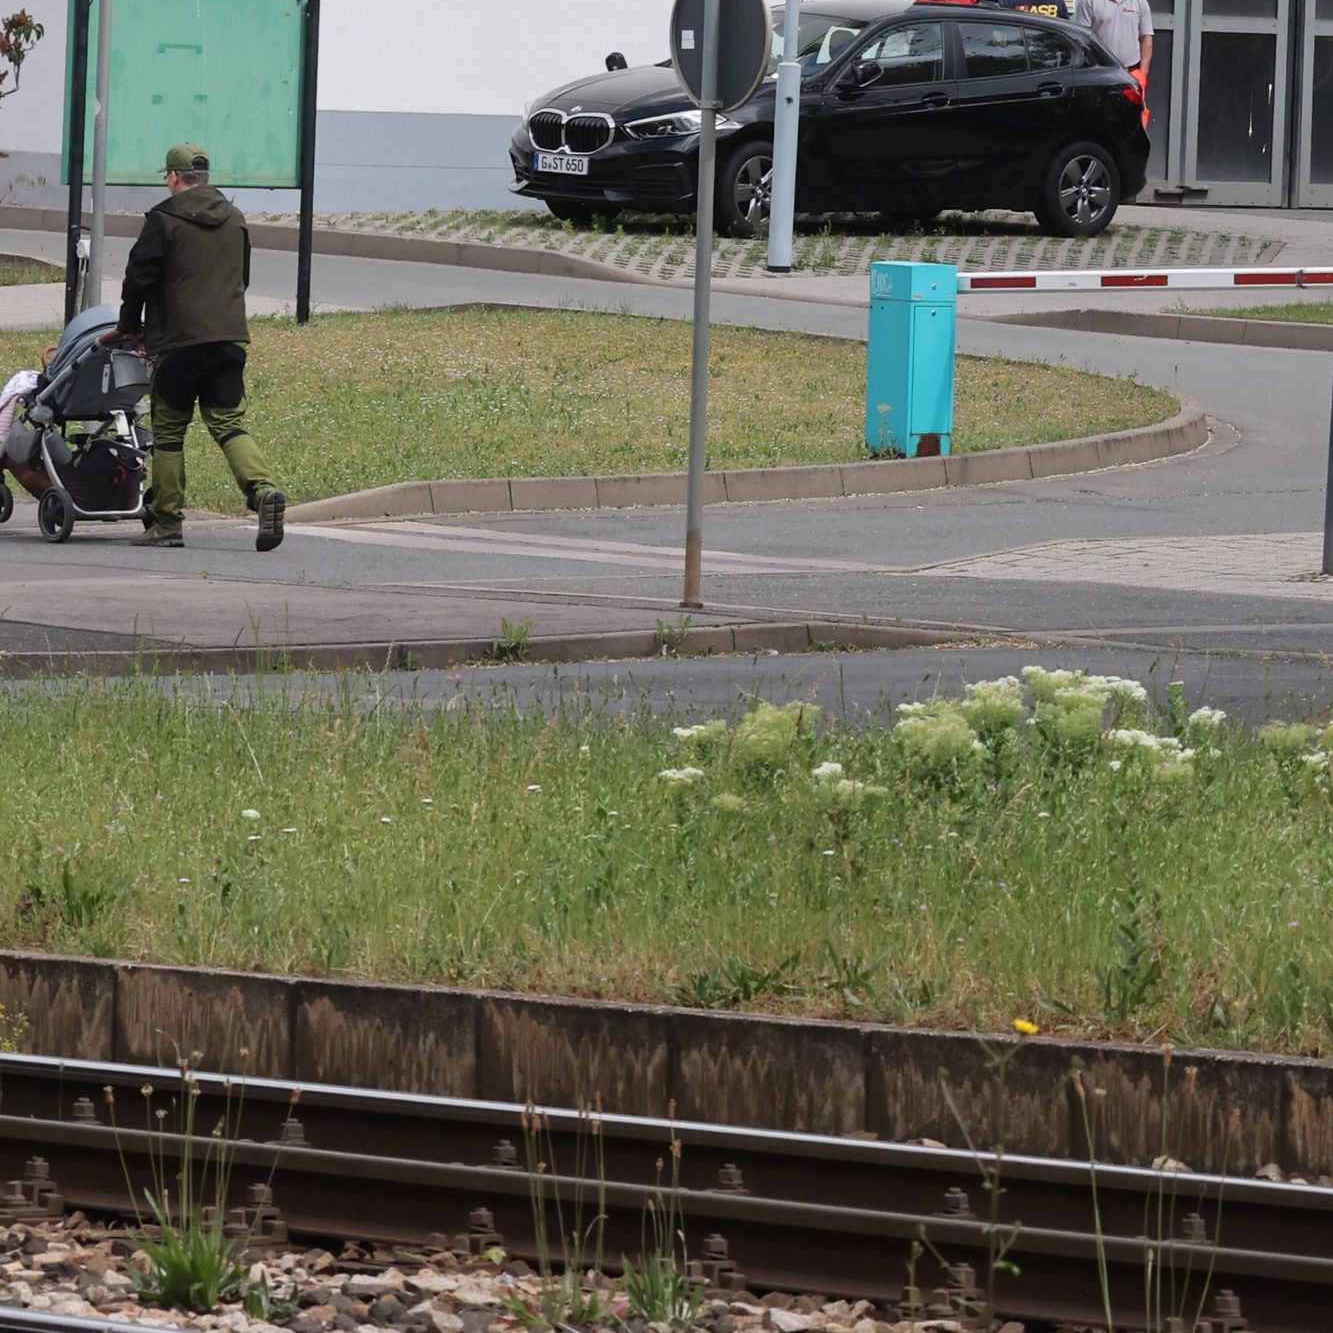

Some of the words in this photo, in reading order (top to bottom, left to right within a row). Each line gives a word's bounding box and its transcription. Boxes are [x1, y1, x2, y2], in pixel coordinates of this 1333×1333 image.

[1030, 4, 1058, 18] ASB
[541, 156, 547, 169] G
[552, 157, 565, 171] ST
[566, 158, 584, 172] 650
